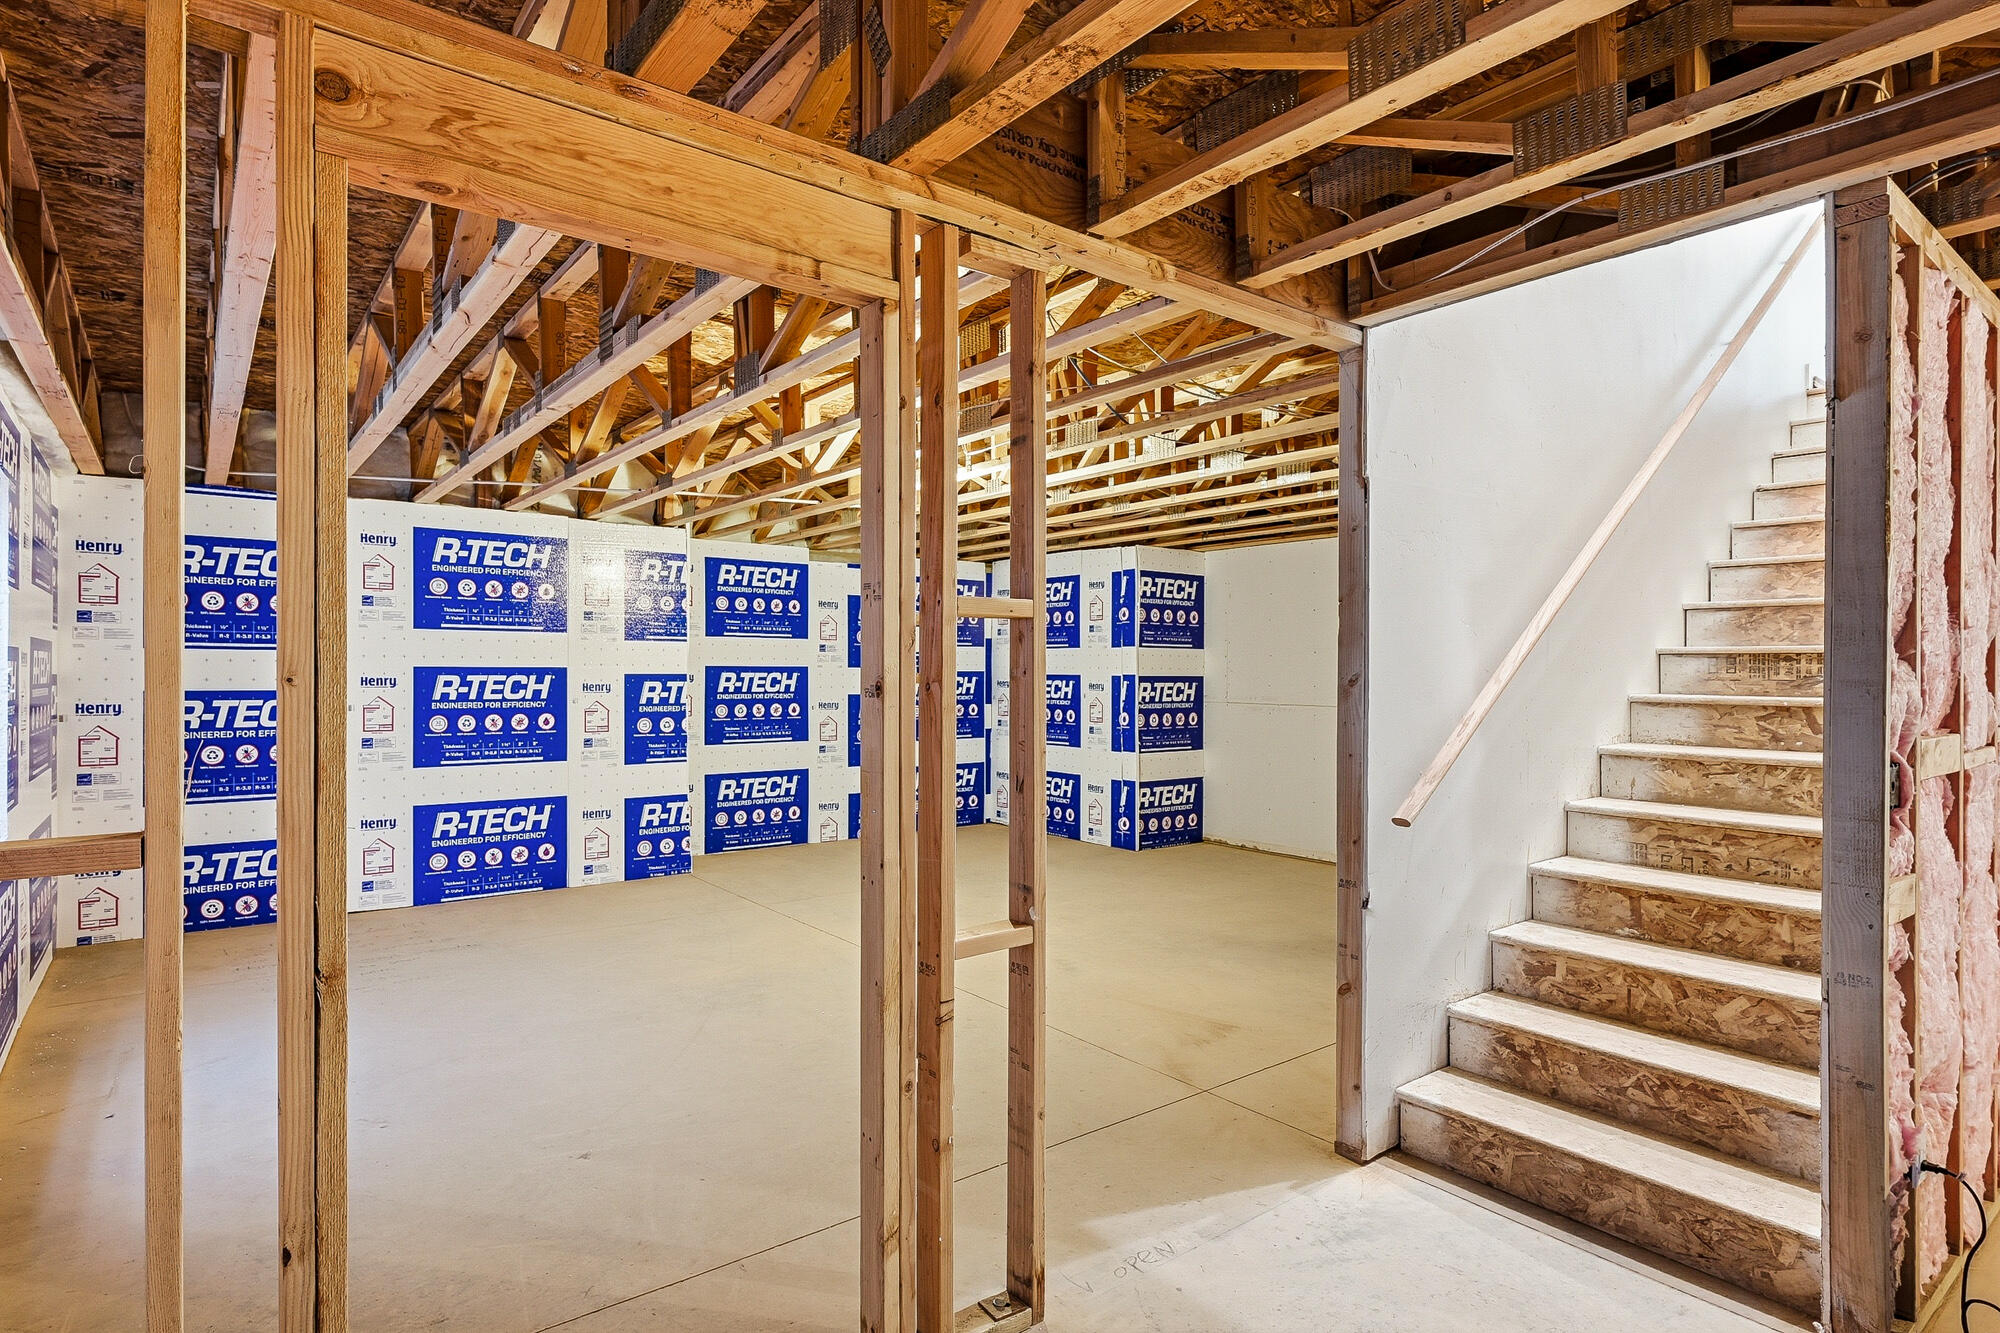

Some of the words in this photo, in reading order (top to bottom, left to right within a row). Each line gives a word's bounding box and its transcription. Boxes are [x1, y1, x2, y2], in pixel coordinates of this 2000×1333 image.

[75, 540, 123, 555] Henry
[360, 533, 397, 547] Henry
[432, 537, 553, 568] R-TECH
[184, 544, 277, 578] R-TEC
[431, 564, 484, 575] ENGINEERED
[485, 567, 501, 575] FOR
[717, 564, 798, 589] R-TECH
[237, 578, 256, 586] FOR
[1140, 576, 1197, 600] R-TECH
[818, 600, 839, 609] Henry
[360, 676, 397, 688] Henry
[432, 675, 552, 700] R-TECH
[582, 683, 611, 693] Henry
[717, 672, 798, 693] R-TECH
[639, 681, 687, 704] R-T
[1139, 682, 1197, 702] R-TECH
[75, 703, 123, 717] Henry
[818, 701, 839, 710] Henry
[184, 699, 277, 729] R-TEC
[184, 731, 234, 739] GINEERED
[236, 730, 256, 738] FOR
[717, 775, 799, 800] R-TECH
[1139, 784, 1196, 807] R-TECH
[582, 809, 611, 820] Henry
[818, 802, 839, 811] Henry
[360, 818, 397, 829] Henry
[432, 805, 552, 838] R-TECH
[431, 836, 484, 848] ENGINEERED
[485, 835, 501, 843] FOR
[502, 831, 547, 841] EFFICIENCY
[184, 849, 277, 884] R-TEC
[184, 883, 234, 895] GINEERED
[236, 881, 256, 890] FOR
